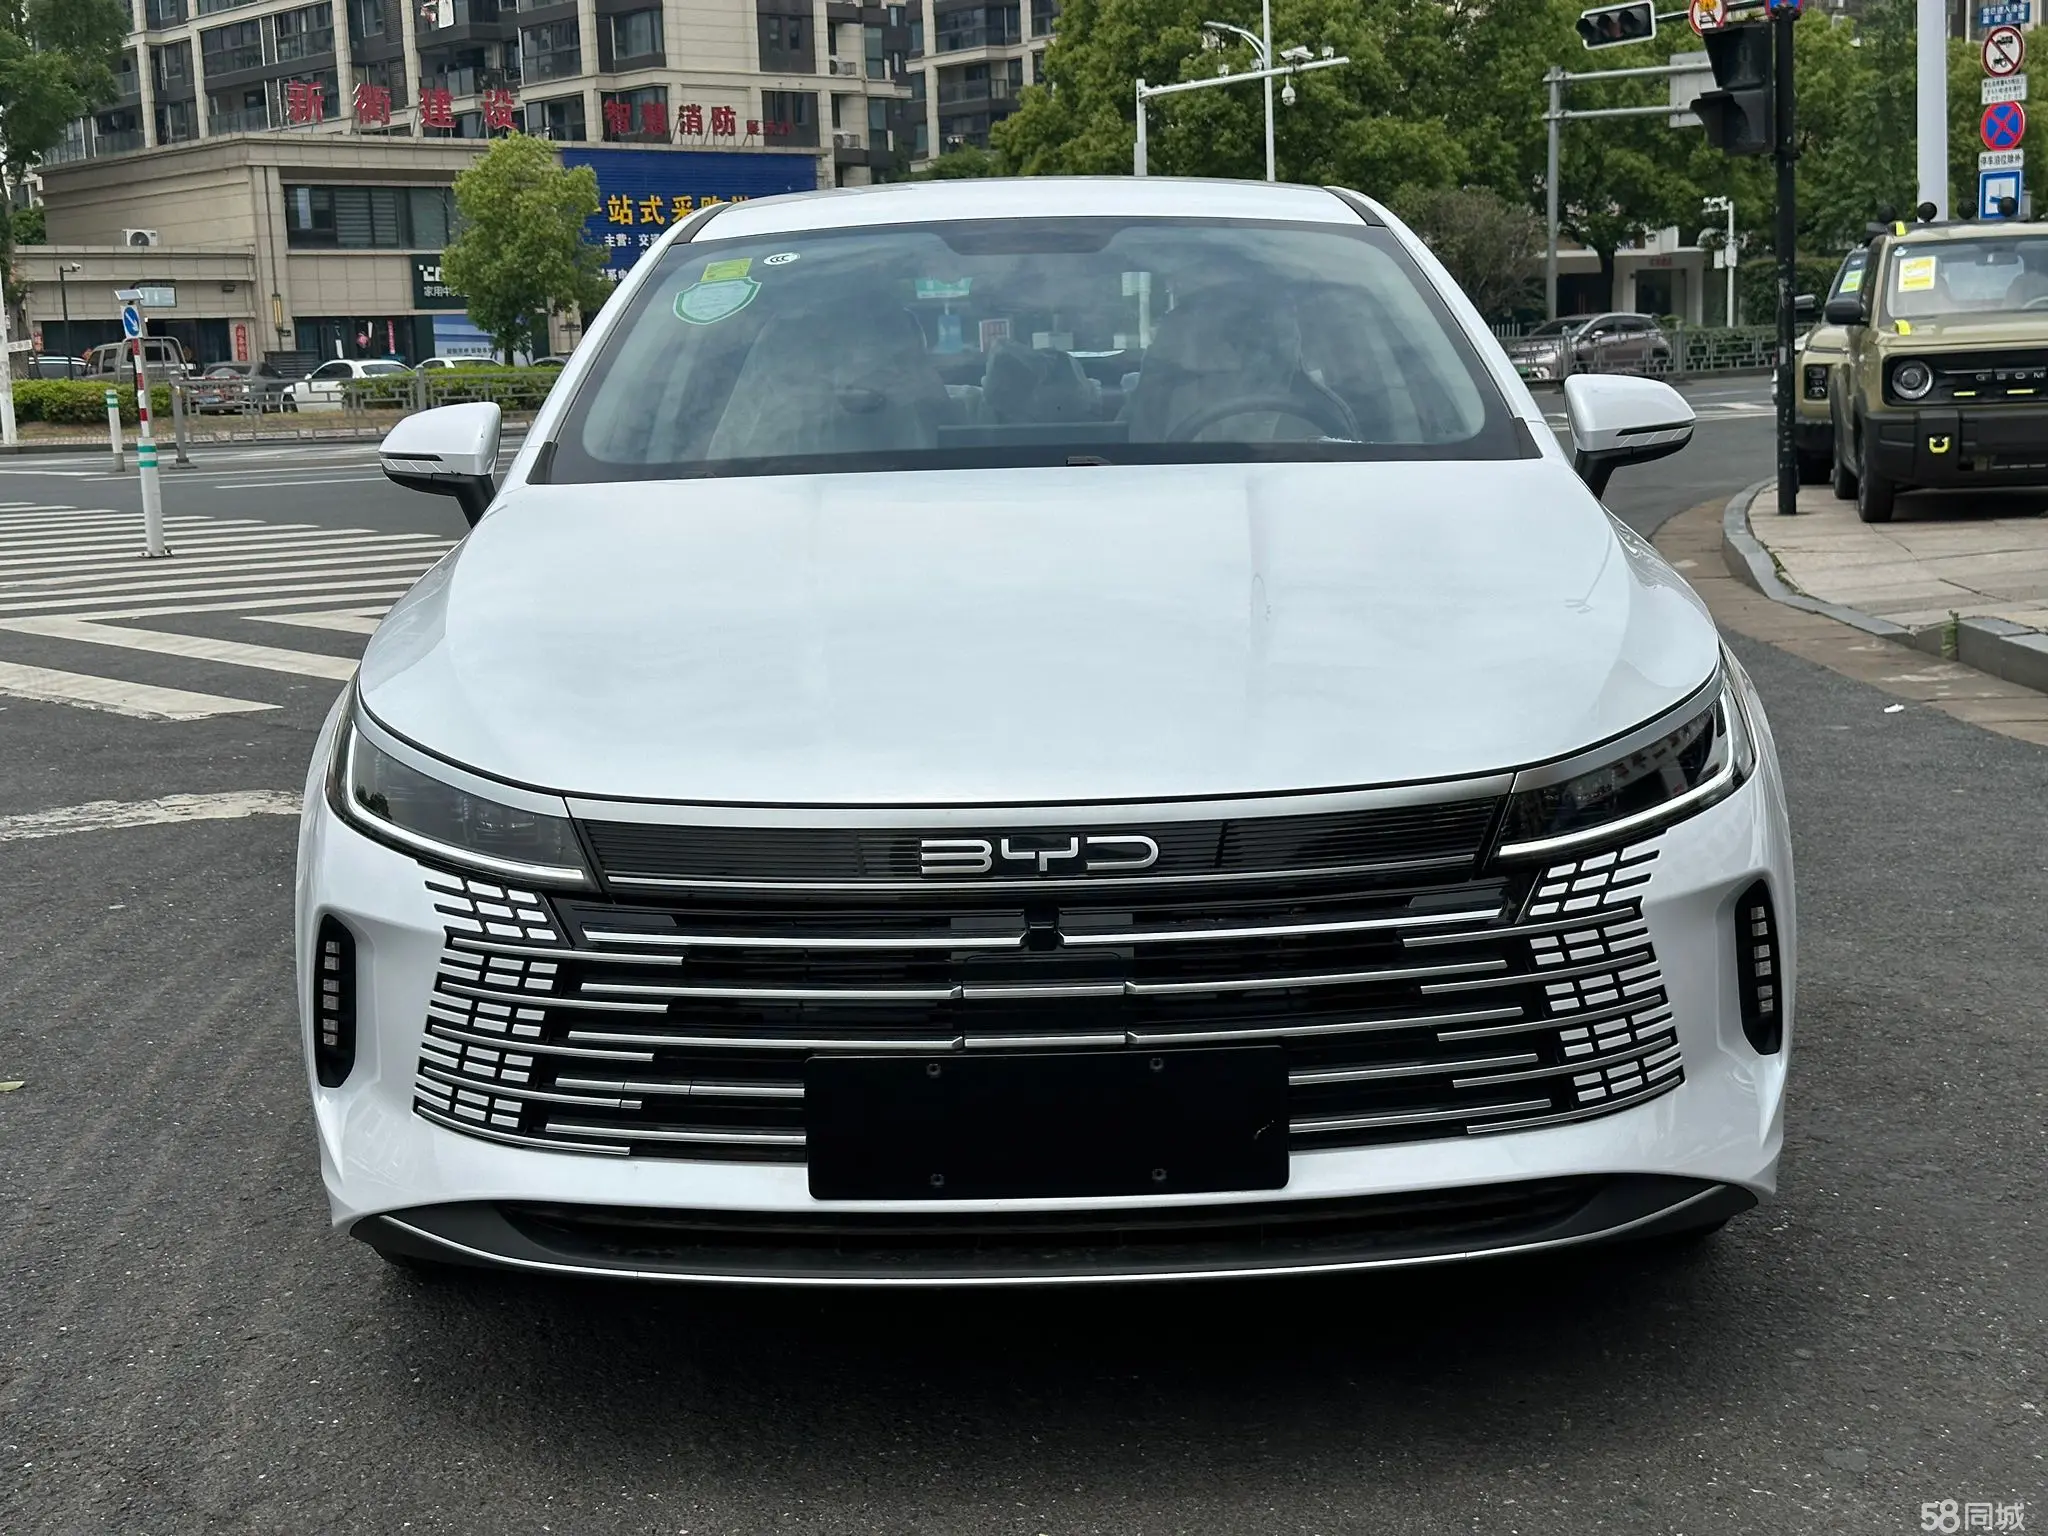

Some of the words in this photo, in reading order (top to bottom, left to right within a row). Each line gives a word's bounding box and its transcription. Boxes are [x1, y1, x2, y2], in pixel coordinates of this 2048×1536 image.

[604, 100, 737, 137] 智慧消防
[920, 834, 1160, 874] BYD
